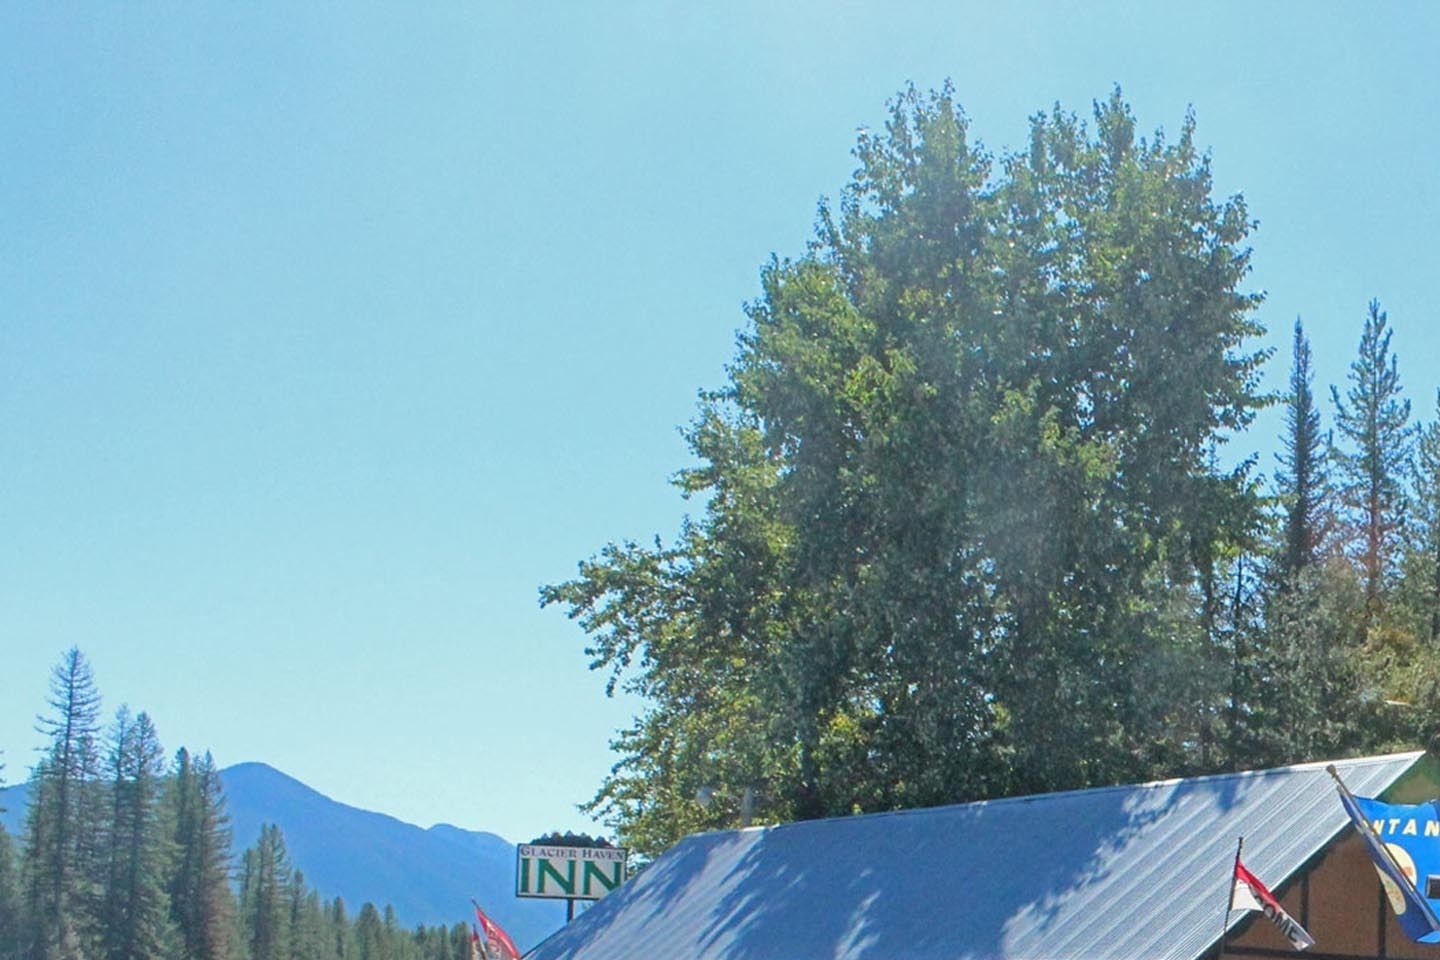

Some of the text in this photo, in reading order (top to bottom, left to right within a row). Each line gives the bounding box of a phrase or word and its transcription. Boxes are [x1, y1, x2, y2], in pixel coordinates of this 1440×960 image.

[521, 846, 624, 860] GLACIER HAVEN
[521, 858, 622, 896] INN
